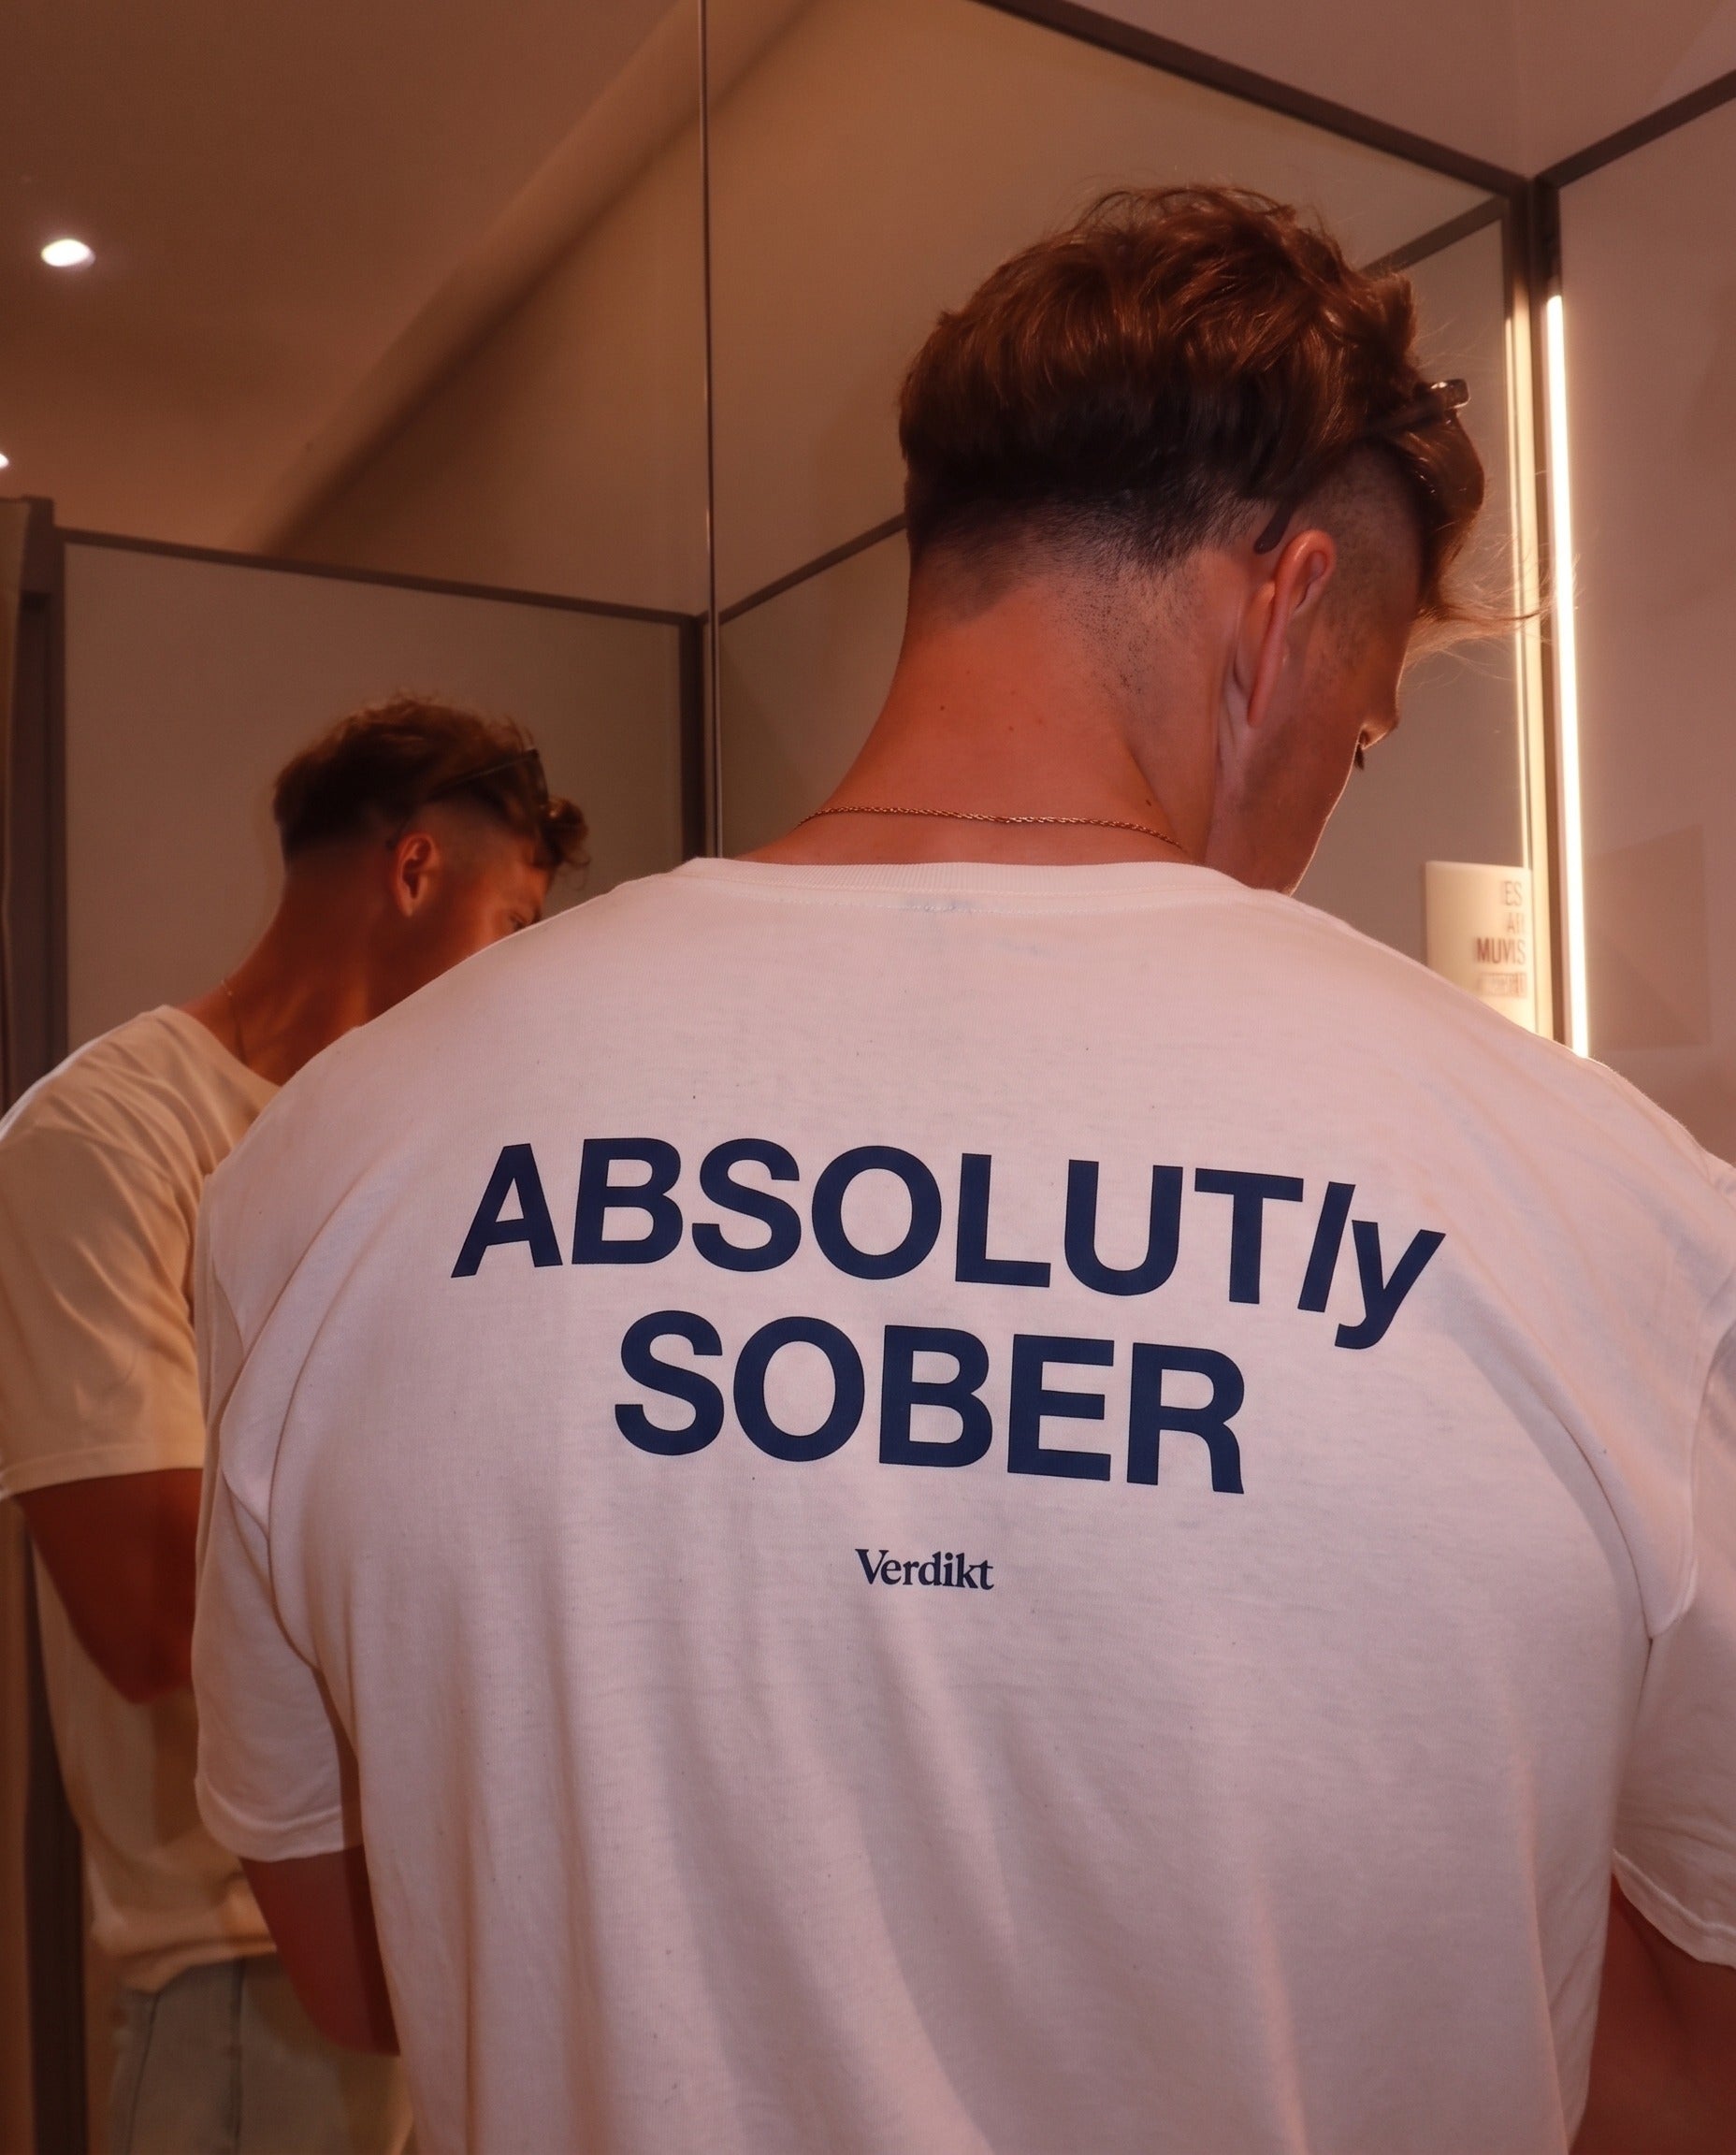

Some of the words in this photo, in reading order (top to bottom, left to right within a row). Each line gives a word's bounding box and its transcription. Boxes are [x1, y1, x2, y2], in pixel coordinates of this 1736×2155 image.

[450, 1136, 1447, 1351] ABSOLUTly
[614, 1309, 1245, 1495] SOBER
[854, 1548, 995, 1591] Verdikt
